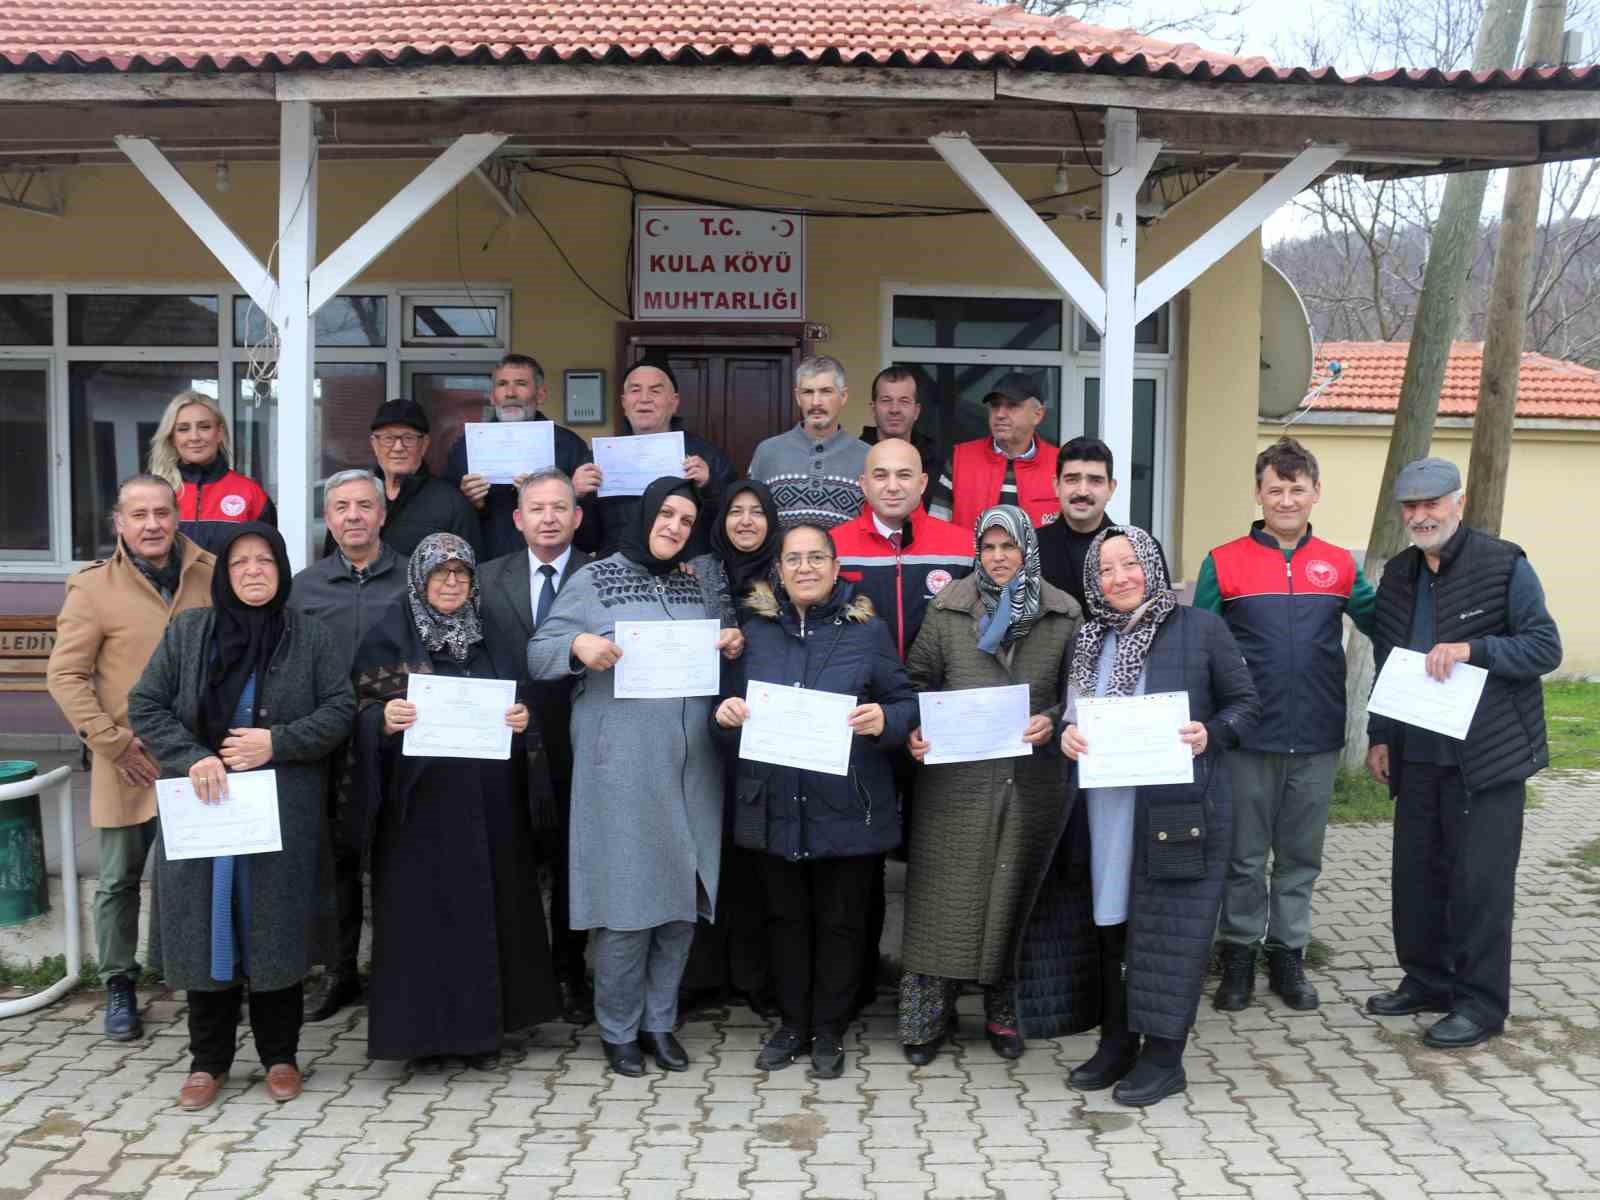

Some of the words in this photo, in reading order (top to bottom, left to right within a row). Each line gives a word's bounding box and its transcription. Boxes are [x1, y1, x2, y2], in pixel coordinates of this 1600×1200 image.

[700, 218, 741, 236] T.C.
[650, 255, 716, 273] KULA
[724, 251, 791, 273] KÖYÜ
[644, 288, 797, 310] MUHTARLIĞI
